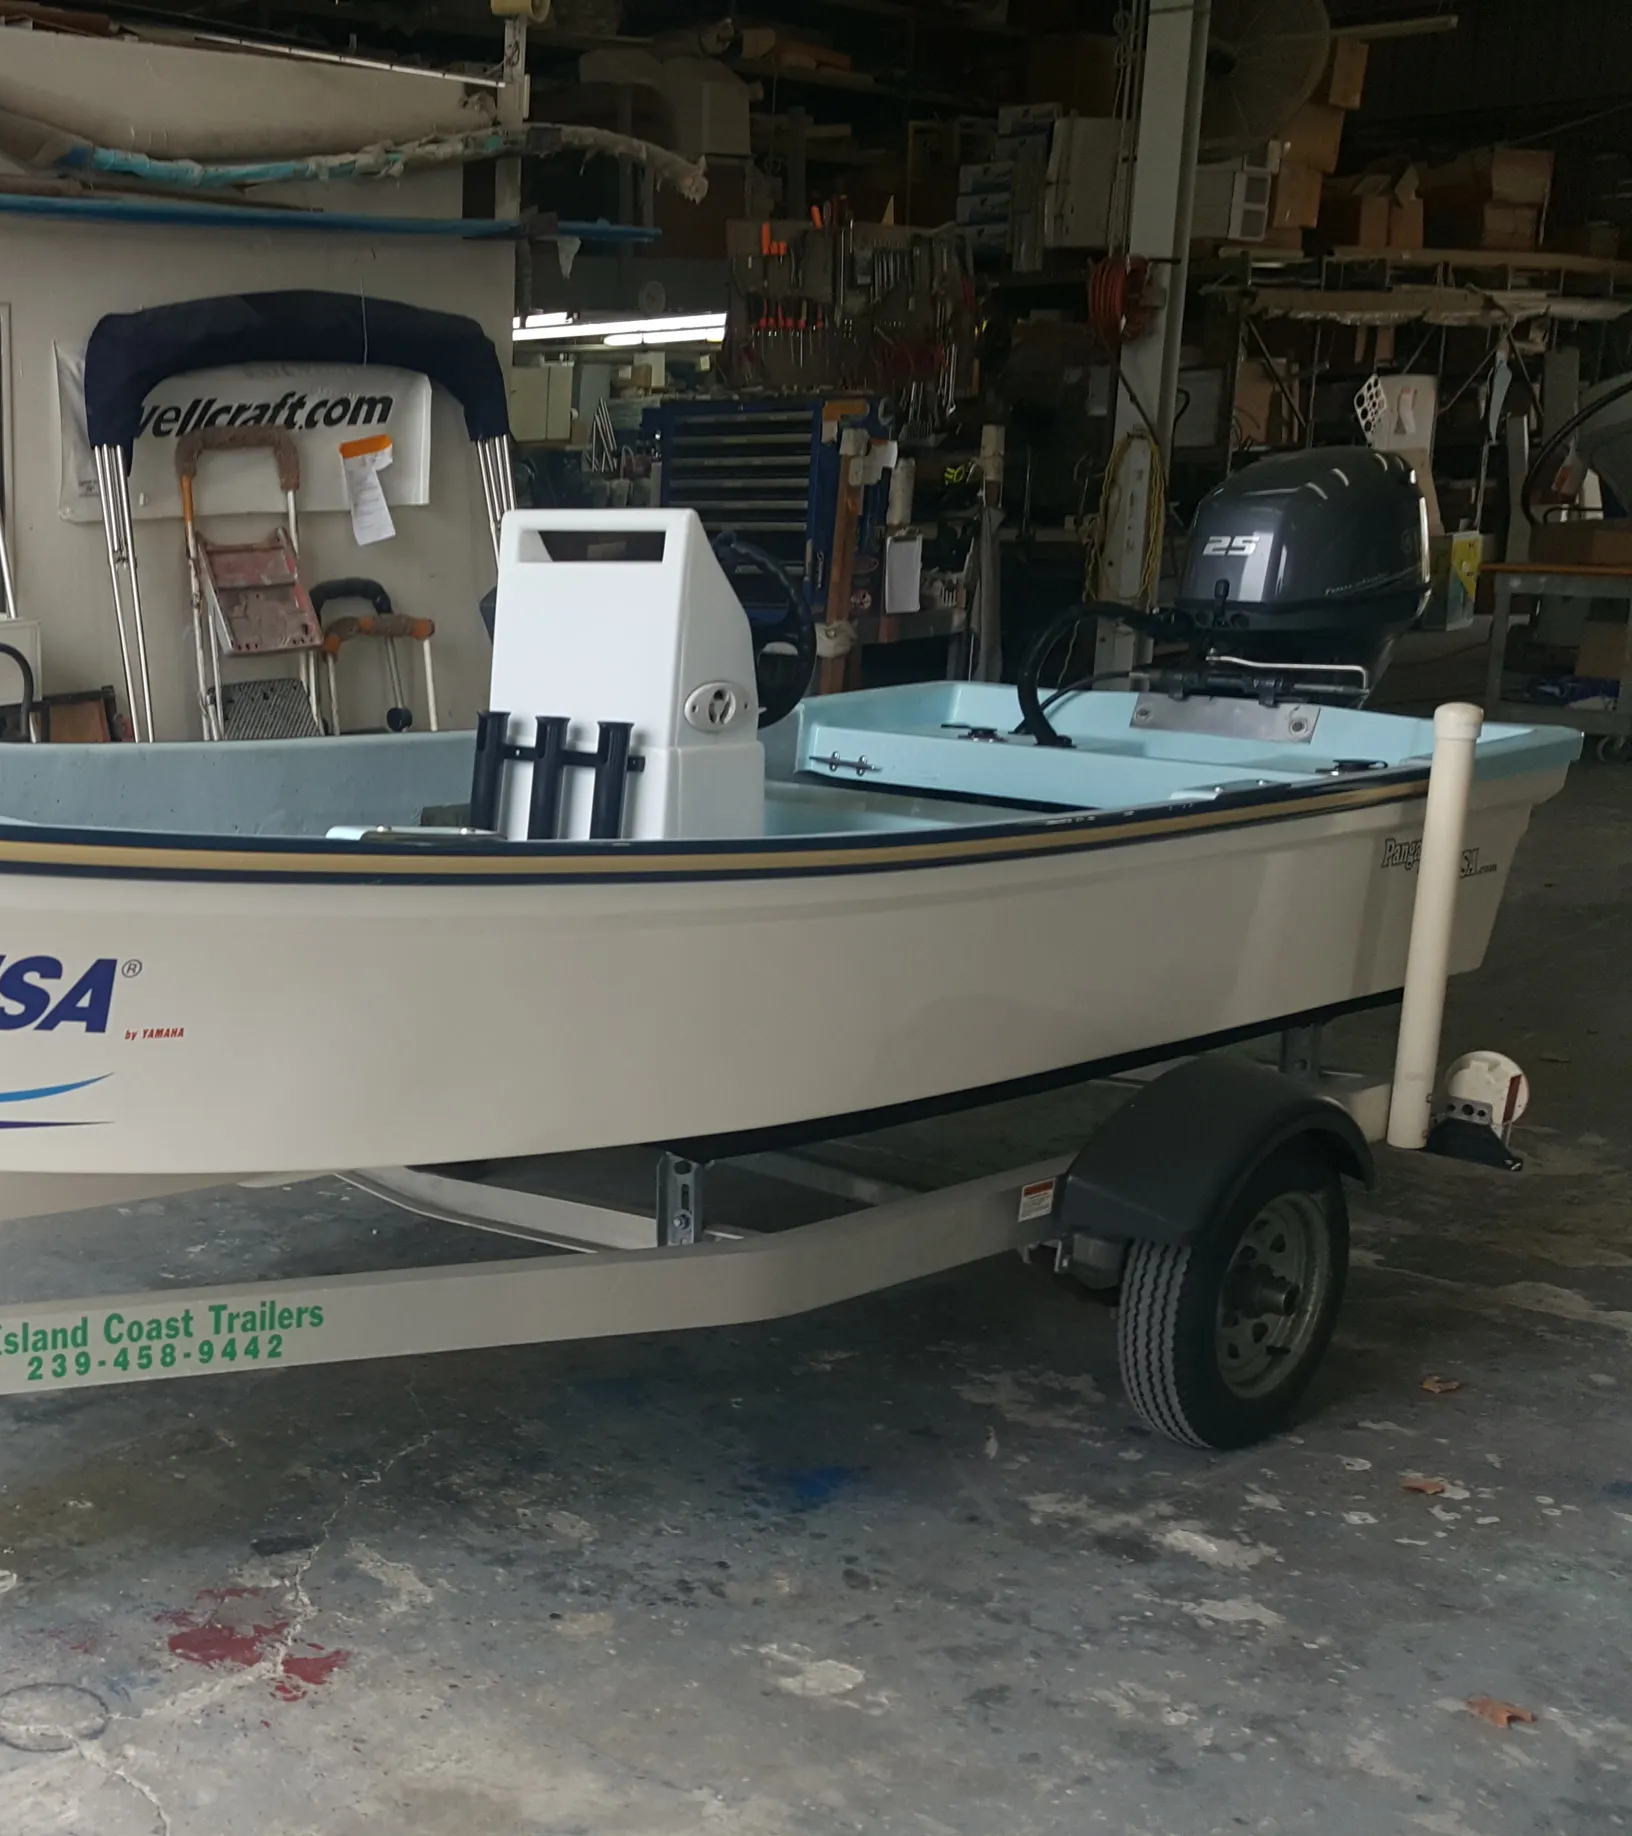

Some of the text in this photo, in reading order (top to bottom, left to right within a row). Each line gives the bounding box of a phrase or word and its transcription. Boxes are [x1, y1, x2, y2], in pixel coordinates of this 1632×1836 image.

[1203, 535, 1261, 556] 25
[124, 1027, 185, 1041] by YAMAHA
[103, 1309, 194, 1344] Coast
[208, 1301, 325, 1336] Trailers
[27, 1334, 284, 1381] 239-458-9442
